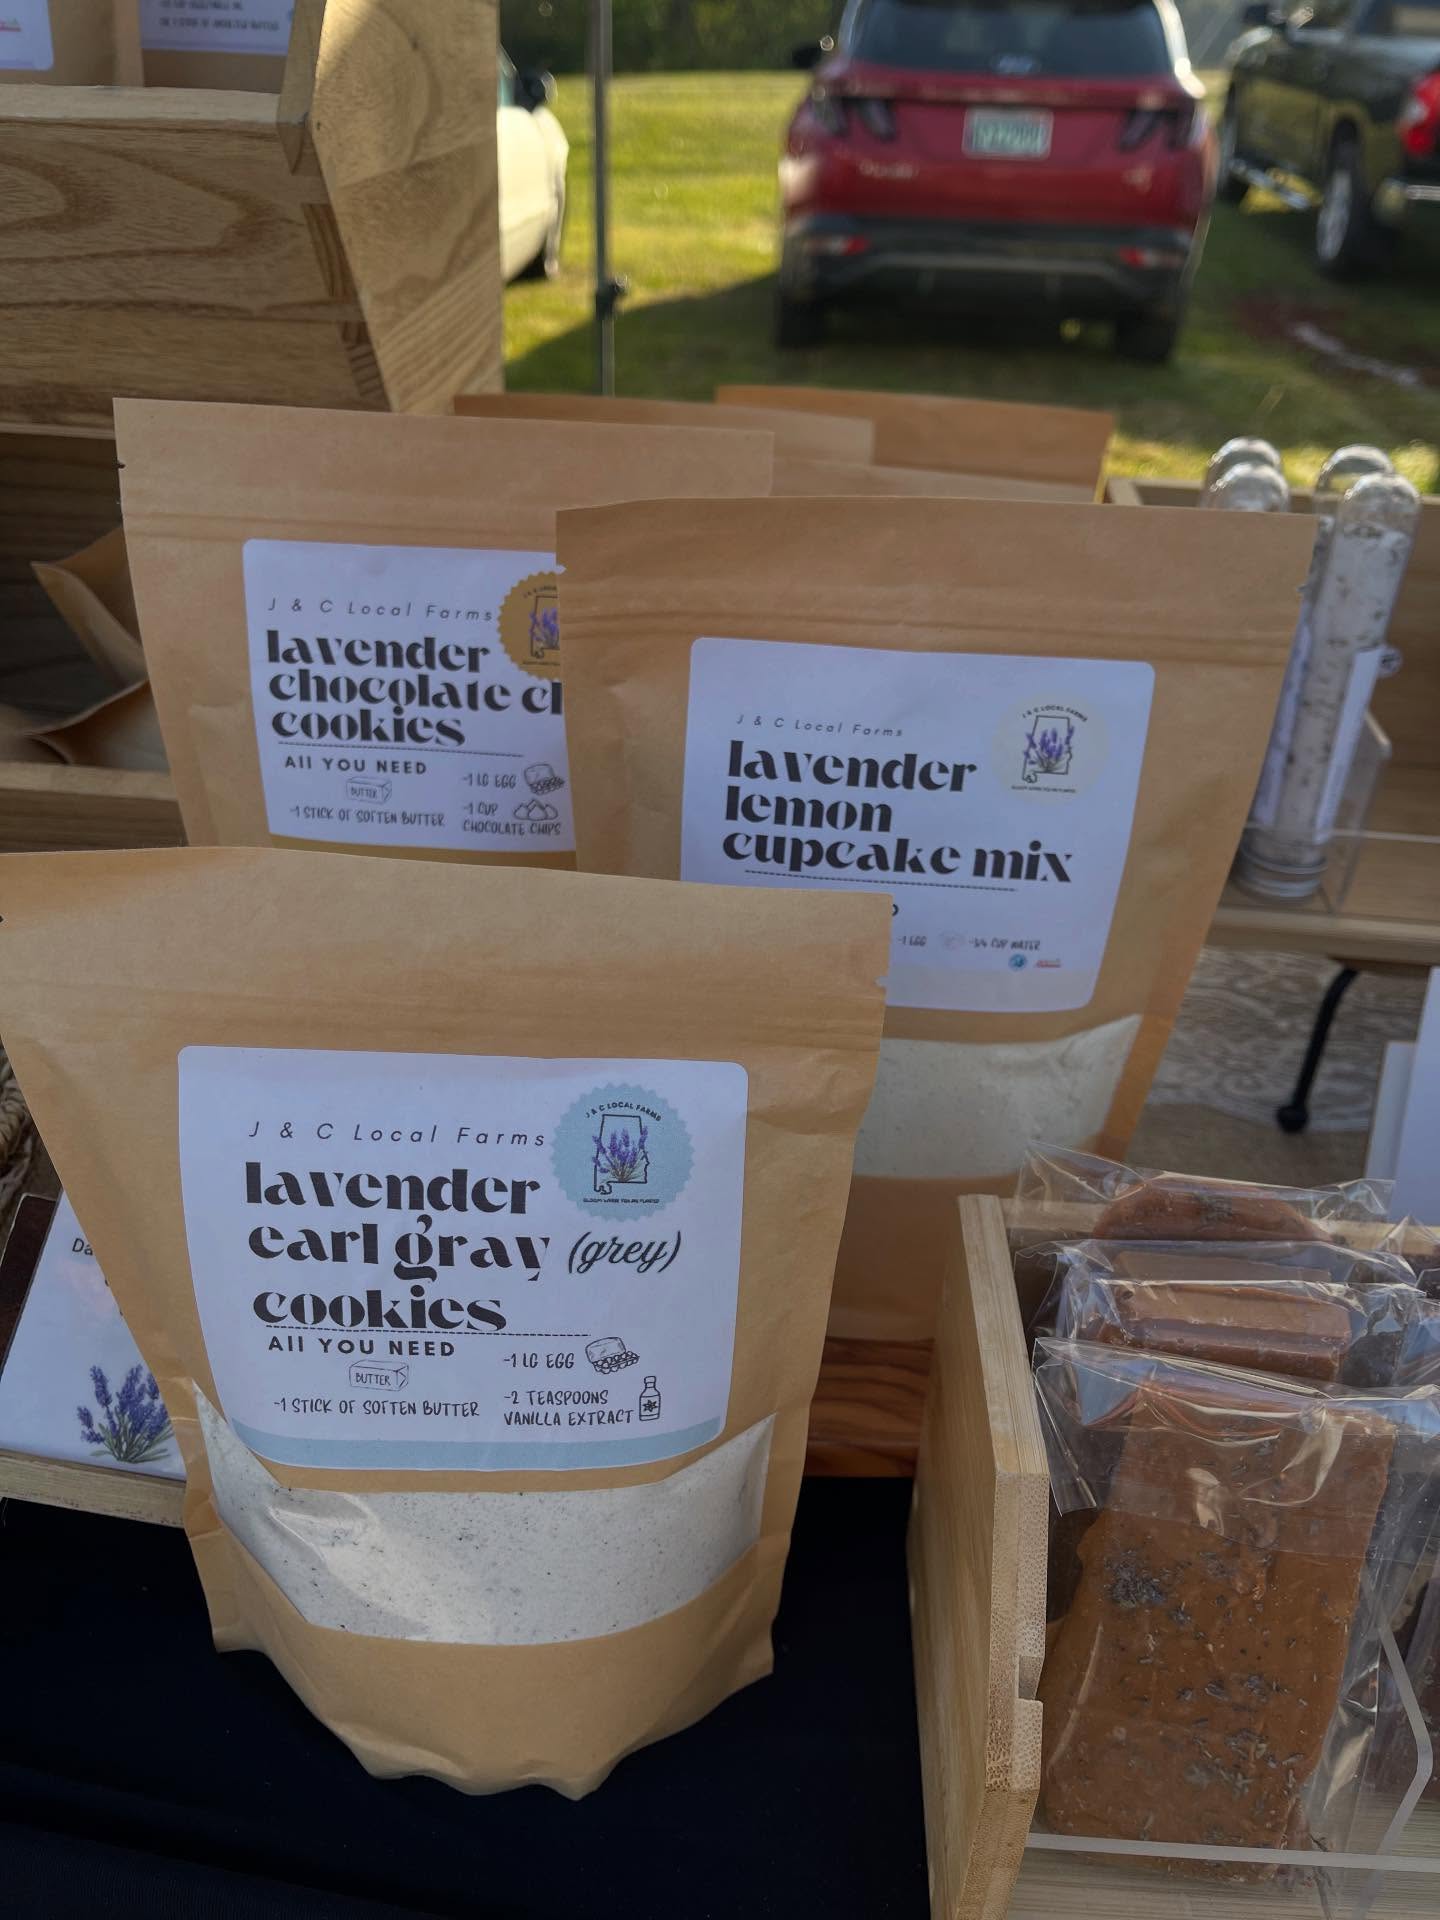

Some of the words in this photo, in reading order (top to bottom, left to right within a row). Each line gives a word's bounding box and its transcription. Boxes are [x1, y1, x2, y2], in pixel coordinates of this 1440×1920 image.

[268, 598, 276, 611] J
[291, 599, 302, 612] &
[320, 600, 333, 613] C
[348, 602, 412, 617] Local
[425, 604, 493, 621] Farms
[266, 629, 491, 673] lavender
[268, 668, 512, 712] chocolate
[271, 705, 467, 747] cookies
[736, 714, 745, 725] J
[753, 716, 763, 727] &
[773, 717, 785, 728] C
[794, 719, 844, 733] Local
[851, 724, 903, 737] Farms
[322, 758, 366, 773] YOU
[376, 761, 428, 775] NEED
[728, 740, 978, 792] lavender
[494, 775, 516, 789] EGG
[303, 806, 334, 820] STICK
[402, 811, 446, 827] BUTTER
[478, 803, 499, 817] CUP
[725, 785, 893, 833] lemon
[462, 821, 526, 837] CHOCOLATE
[528, 821, 562, 837] CHIPS
[722, 831, 962, 874] cupcake
[972, 840, 1073, 883] mix
[599, 1104, 606, 1112] C
[607, 1101, 634, 1111] LOCAL
[635, 1104, 662, 1122] FARMS
[248, 1121, 260, 1138] J
[279, 1121, 294, 1139] &
[316, 1123, 334, 1140] C
[354, 1124, 438, 1143] Local
[456, 1127, 545, 1146] Farms
[245, 1161, 542, 1214] lavender
[248, 1222, 380, 1265] earl
[393, 1213, 551, 1282] gray
[567, 1230, 682, 1274] (grey)
[252, 1284, 507, 1332] cookies
[317, 1338, 376, 1355] YOU
[388, 1340, 456, 1357] NEED
[503, 1352, 517, 1368] -1
[522, 1352, 538, 1369] LG
[546, 1352, 575, 1369] EGG
[355, 1372, 392, 1387] BUTTER
[273, 1397, 287, 1412] -1
[291, 1398, 333, 1414] STICK
[422, 1400, 481, 1418] BUTTER
[503, 1390, 518, 1405] -2
[526, 1389, 609, 1406] TEASPOONS
[503, 1409, 562, 1426] VANILLA
[568, 1408, 635, 1426] EXTRACT
